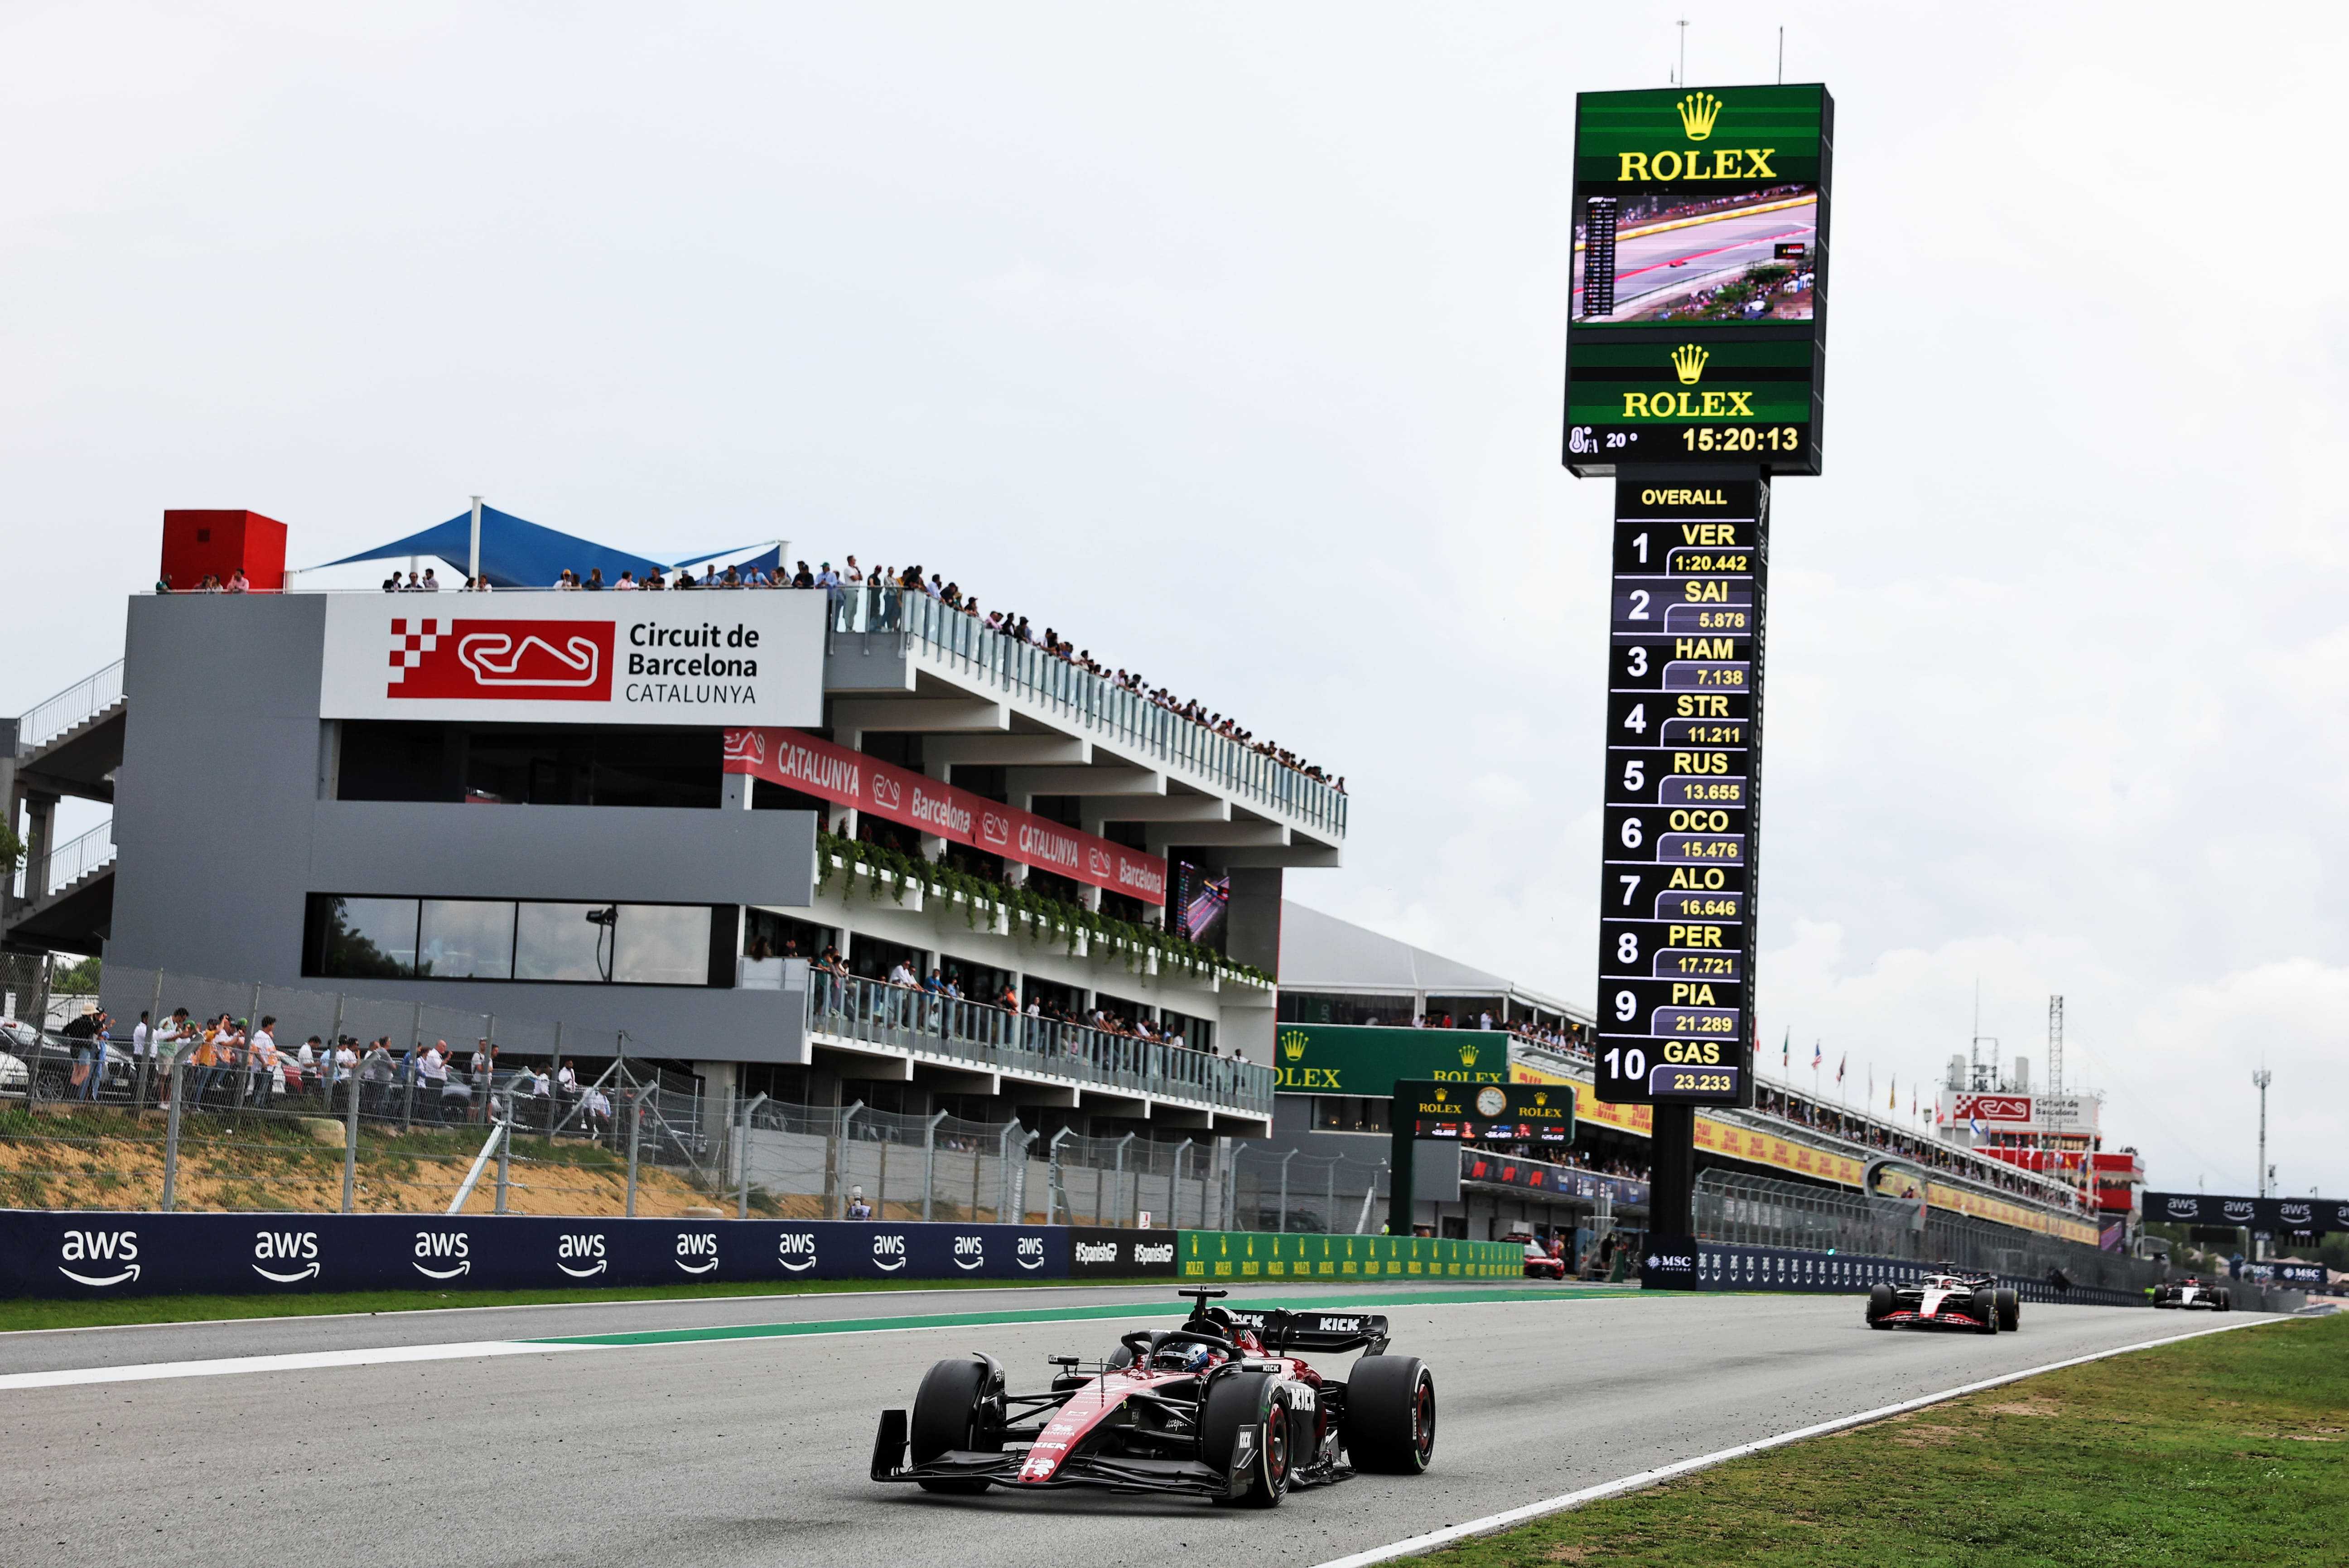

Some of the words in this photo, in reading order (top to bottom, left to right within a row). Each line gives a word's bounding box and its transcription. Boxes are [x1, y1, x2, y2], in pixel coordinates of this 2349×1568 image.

[1618, 149, 1776, 181] ROLEX
[1623, 392, 1754, 417] ROLEX
[1683, 428, 1798, 451] 15:20:13
[1642, 489, 1727, 505] OVERALL
[1633, 533, 1647, 563] 1
[1682, 524, 1735, 545] VER
[1676, 555, 1746, 570] 1:20.442
[1629, 590, 1650, 619] 2
[1685, 581, 1727, 602] SAI
[1700, 613, 1745, 627] 5.878
[630, 622, 721, 647] Circuit
[728, 624, 759, 647] de
[629, 653, 757, 676] Barcelona
[1627, 646, 1647, 676] 3
[1676, 638, 1733, 659] HAM
[1698, 670, 1742, 685] 7.138
[627, 684, 755, 703] CATALUNYA
[1625, 704, 1646, 733] 4
[1677, 695, 1728, 716] STR
[1688, 727, 1739, 742] 11.211
[778, 742, 859, 797] CATALUNYA
[1624, 761, 1644, 791] 5
[1674, 753, 1727, 774] RUS
[1684, 784, 1739, 800] 13.655
[912, 787, 970, 834] Barcelona
[1622, 818, 1642, 848] 6
[1670, 810, 1728, 831] OCO
[1019, 824, 1078, 867] CATALUNYA
[1683, 842, 1737, 858] 15.476
[1119, 858, 1161, 893] Barcelona
[1620, 875, 1640, 905] 7
[1669, 868, 1725, 889] ALO
[1681, 900, 1736, 915] 16.646
[1618, 933, 1638, 963] 8
[1669, 926, 1722, 947] PER
[1679, 958, 1732, 974] 17.721
[1616, 991, 1636, 1021] 9
[1673, 984, 1716, 1005] PIA
[1676, 1016, 1732, 1032] 21.289
[1605, 1048, 1645, 1080] 10
[1664, 1042, 1720, 1064] GAS
[1274, 1067, 1341, 1088] OLEX
[1674, 1075, 1730, 1090] 23.233
[1419, 1103, 1462, 1114] ROLEX
[1519, 1107, 1562, 1118] ROLEX
[2168, 1198, 2197, 1211] aws
[2224, 1201, 2253, 1212] aws
[2281, 1204, 2310, 1215] aws
[63, 1231, 137, 1260] aws
[256, 1232, 317, 1258] aws
[415, 1232, 468, 1257] aws
[559, 1235, 605, 1257] aws
[677, 1233, 717, 1255] aws
[780, 1233, 815, 1254] aws
[874, 1235, 904, 1254] aws
[955, 1237, 982, 1254] aws
[1018, 1238, 1042, 1254] aws
[1662, 1255, 1692, 1267] MSC
[1237, 1314, 1264, 1327] ICK
[1320, 1317, 1360, 1331] KICK
[1290, 1388, 1315, 1411] KICK
[1032, 1442, 1067, 1451] KICK
[1239, 1432, 1251, 1448] KICK
